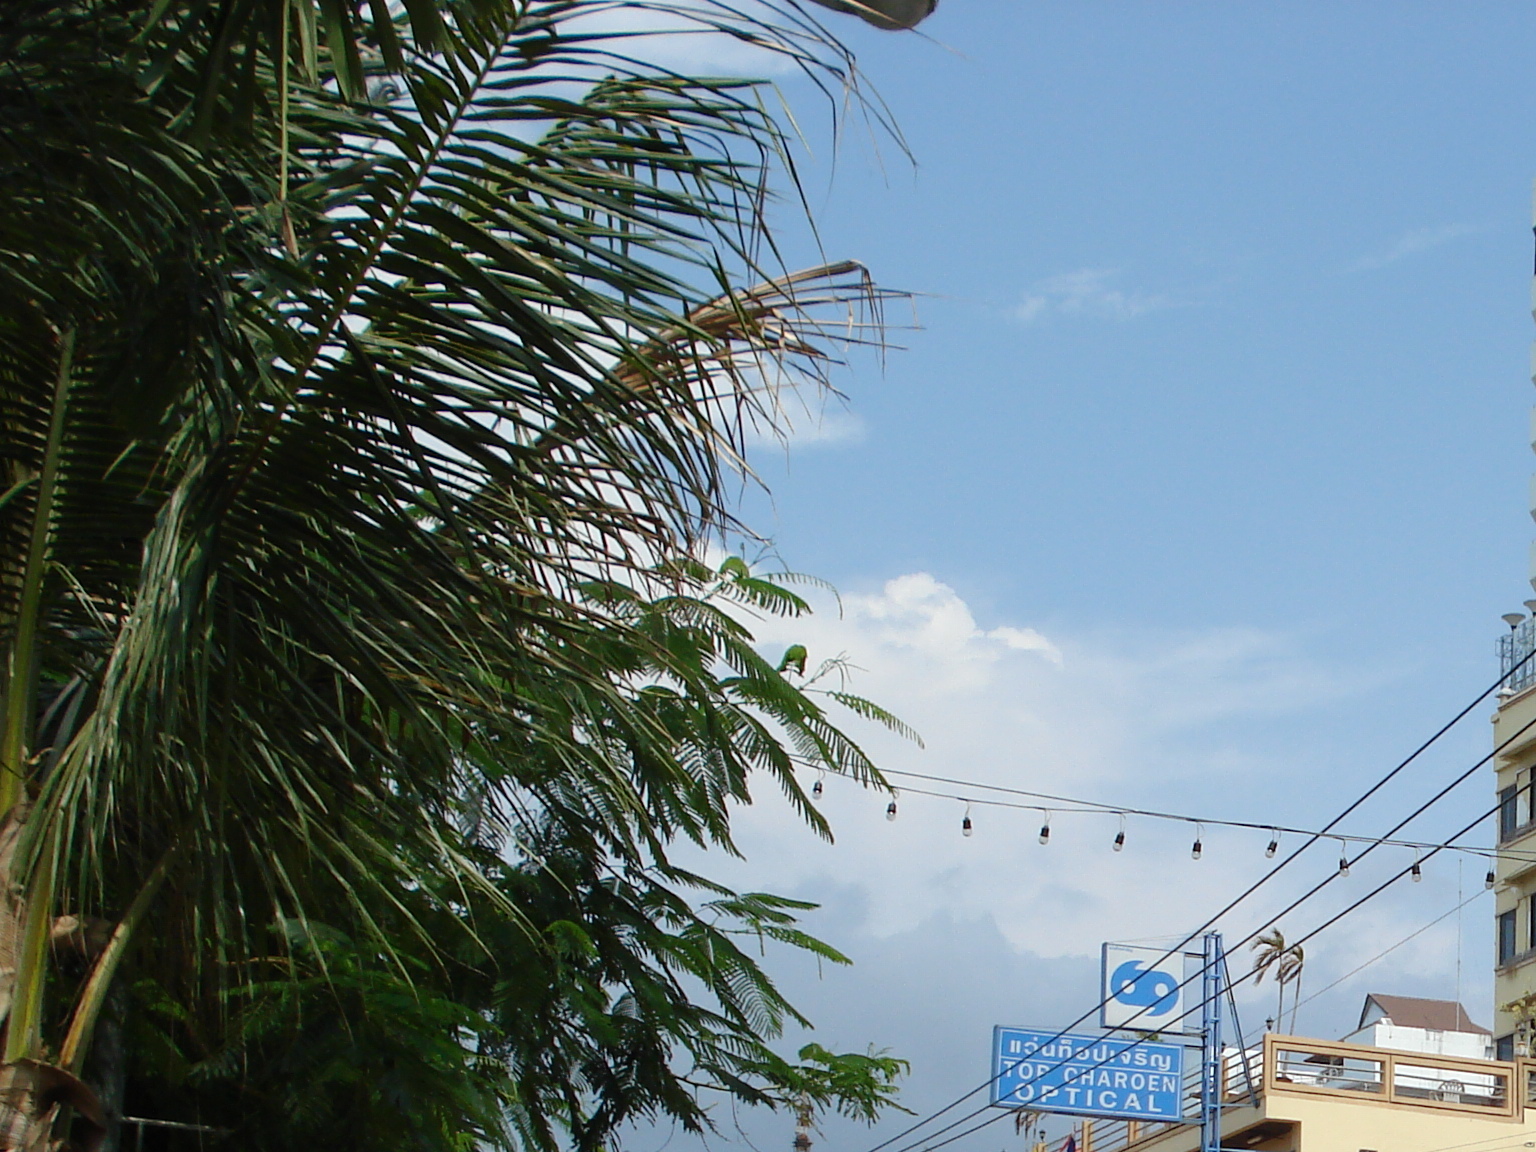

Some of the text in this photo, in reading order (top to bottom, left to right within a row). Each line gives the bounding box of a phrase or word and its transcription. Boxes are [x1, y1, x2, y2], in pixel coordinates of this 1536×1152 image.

[1004, 1061, 1176, 1093] TOP CHAROEN
[1014, 1083, 1163, 1113] OPTICAL
